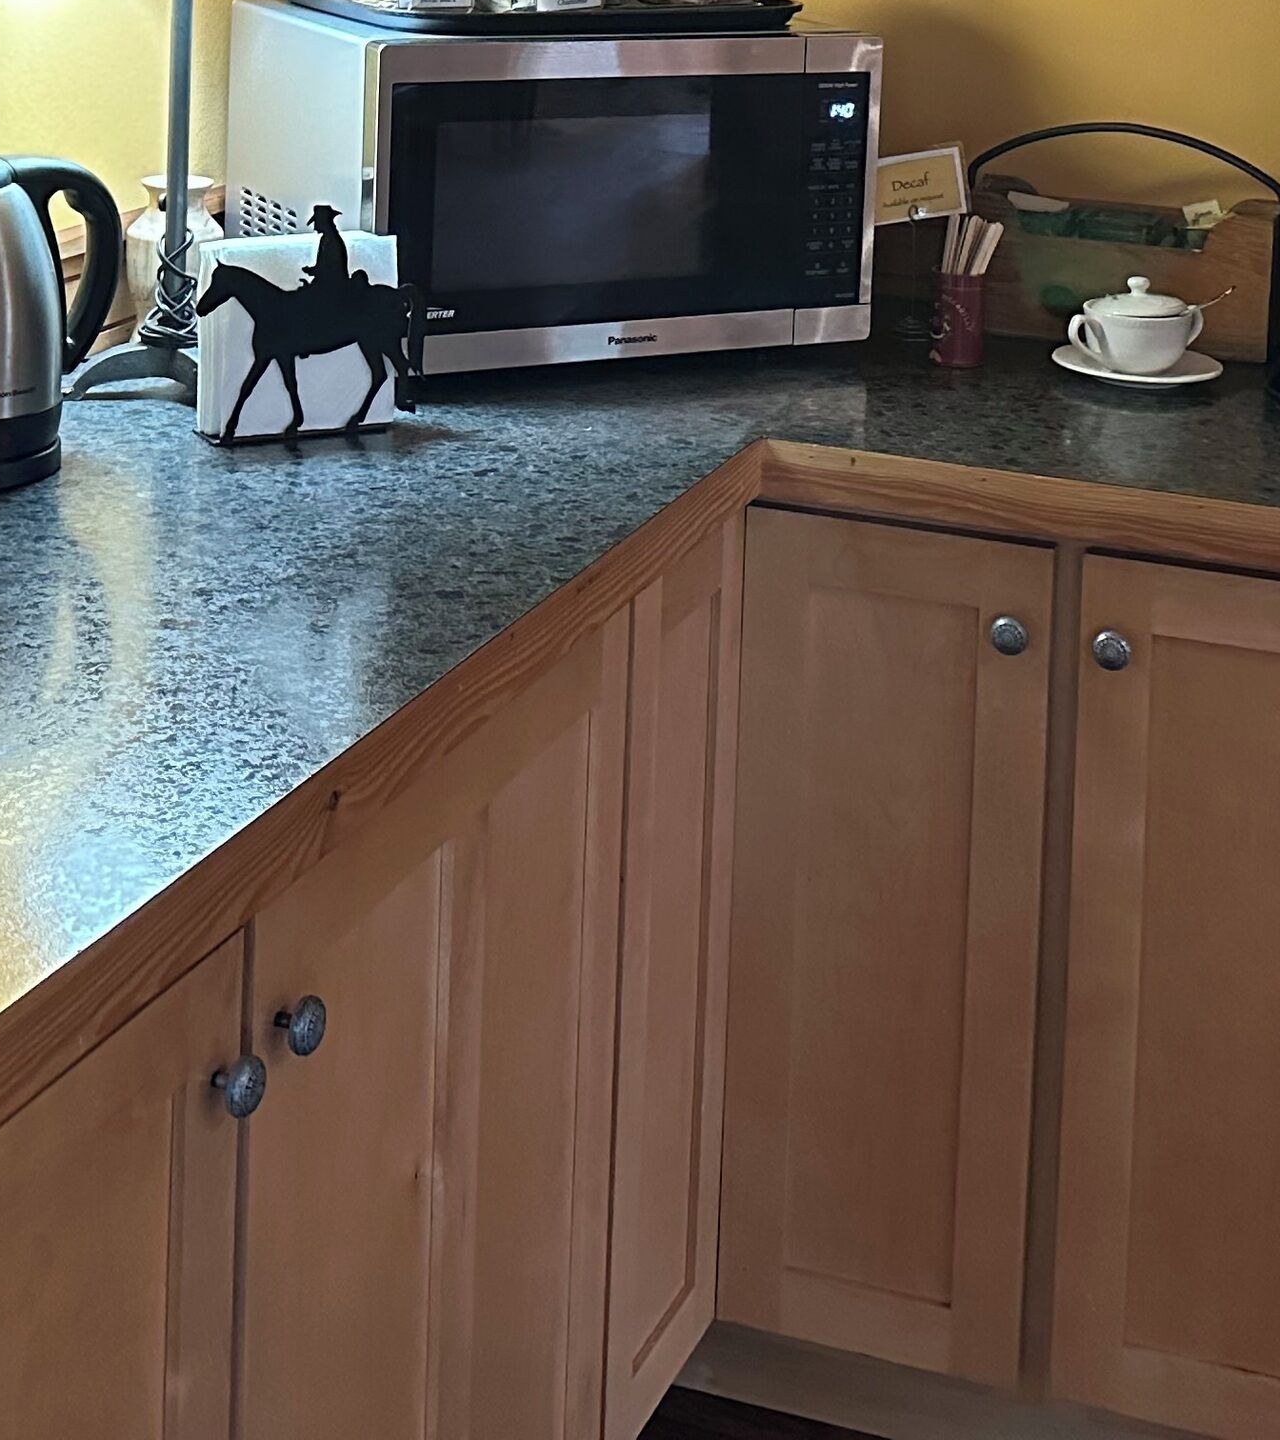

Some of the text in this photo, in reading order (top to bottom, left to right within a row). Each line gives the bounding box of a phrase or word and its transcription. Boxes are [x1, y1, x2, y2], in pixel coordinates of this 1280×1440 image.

[891, 171, 930, 192] Decaf
[426, 310, 455, 320] ERTER
[607, 333, 658, 346] Panasonic
